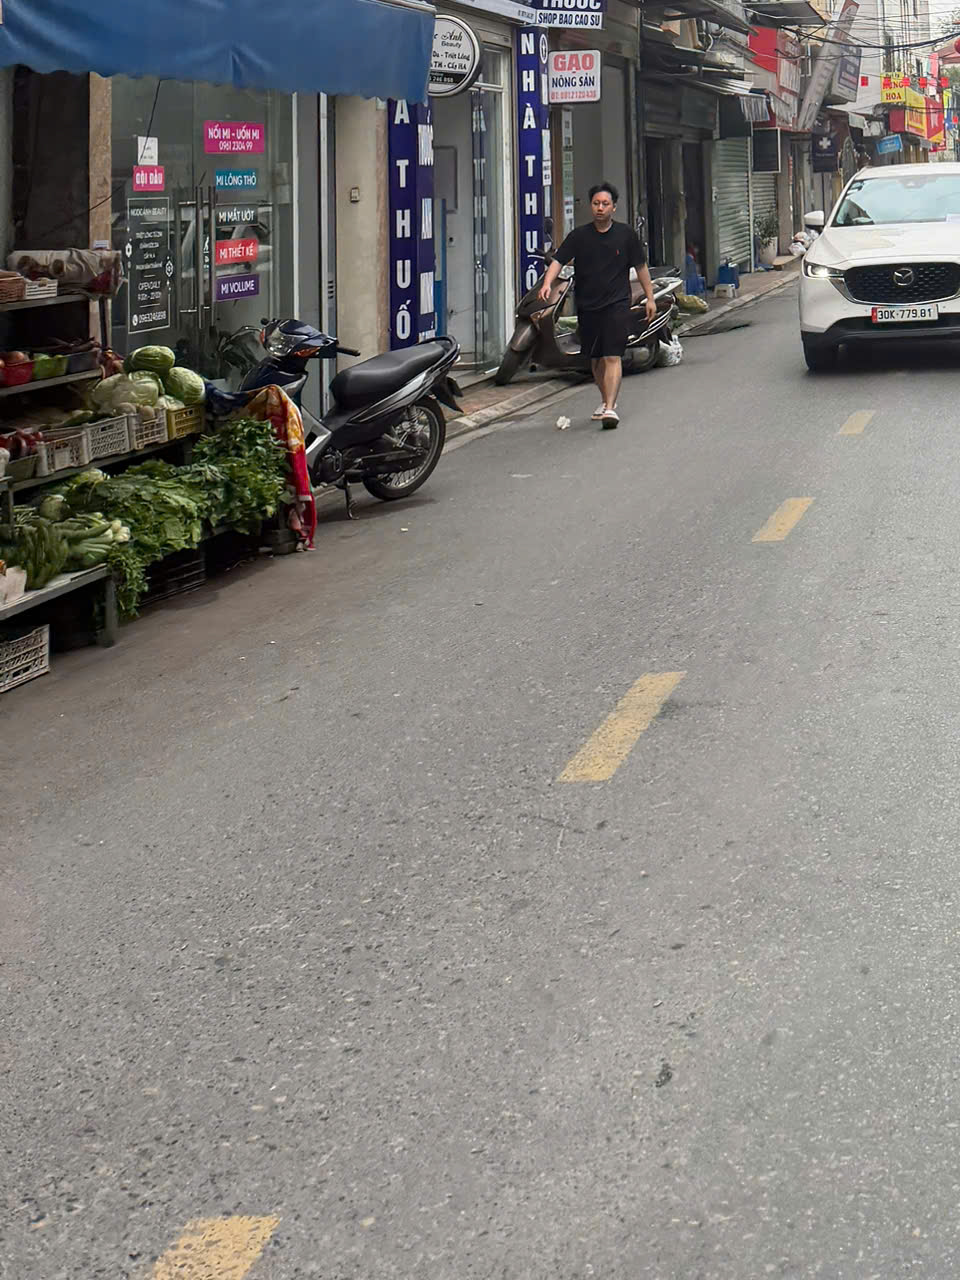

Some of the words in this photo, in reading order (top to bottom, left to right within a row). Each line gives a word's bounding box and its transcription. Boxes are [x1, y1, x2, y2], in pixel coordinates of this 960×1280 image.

[538, 12, 558, 26] SHOP
[558, 12, 573, 25] BAO
[574, 14, 589, 26] CAO
[590, 14, 601, 26] SU
[553, 53, 595, 74] GẠO
[521, 32, 537, 129] NHÀ
[552, 75, 577, 88] NÔNG
[578, 72, 595, 87] SẢN
[208, 125, 222, 140] NỐI
[222, 129, 231, 140] MI
[236, 125, 251, 140] UỐN
[251, 129, 260, 140] MI
[219, 141, 232, 152] 0961
[246, 141, 253, 151] 99
[216, 176, 225, 186] MI
[225, 174, 243, 186] LÔNG
[219, 212, 227, 222] MI
[219, 248, 228, 259] MI
[228, 244, 244, 258] THIẾT
[245, 244, 254, 256] KẾ
[395, 159, 411, 340] THUỐ
[221, 284, 229, 294] MI
[229, 279, 255, 293] VOLUME
